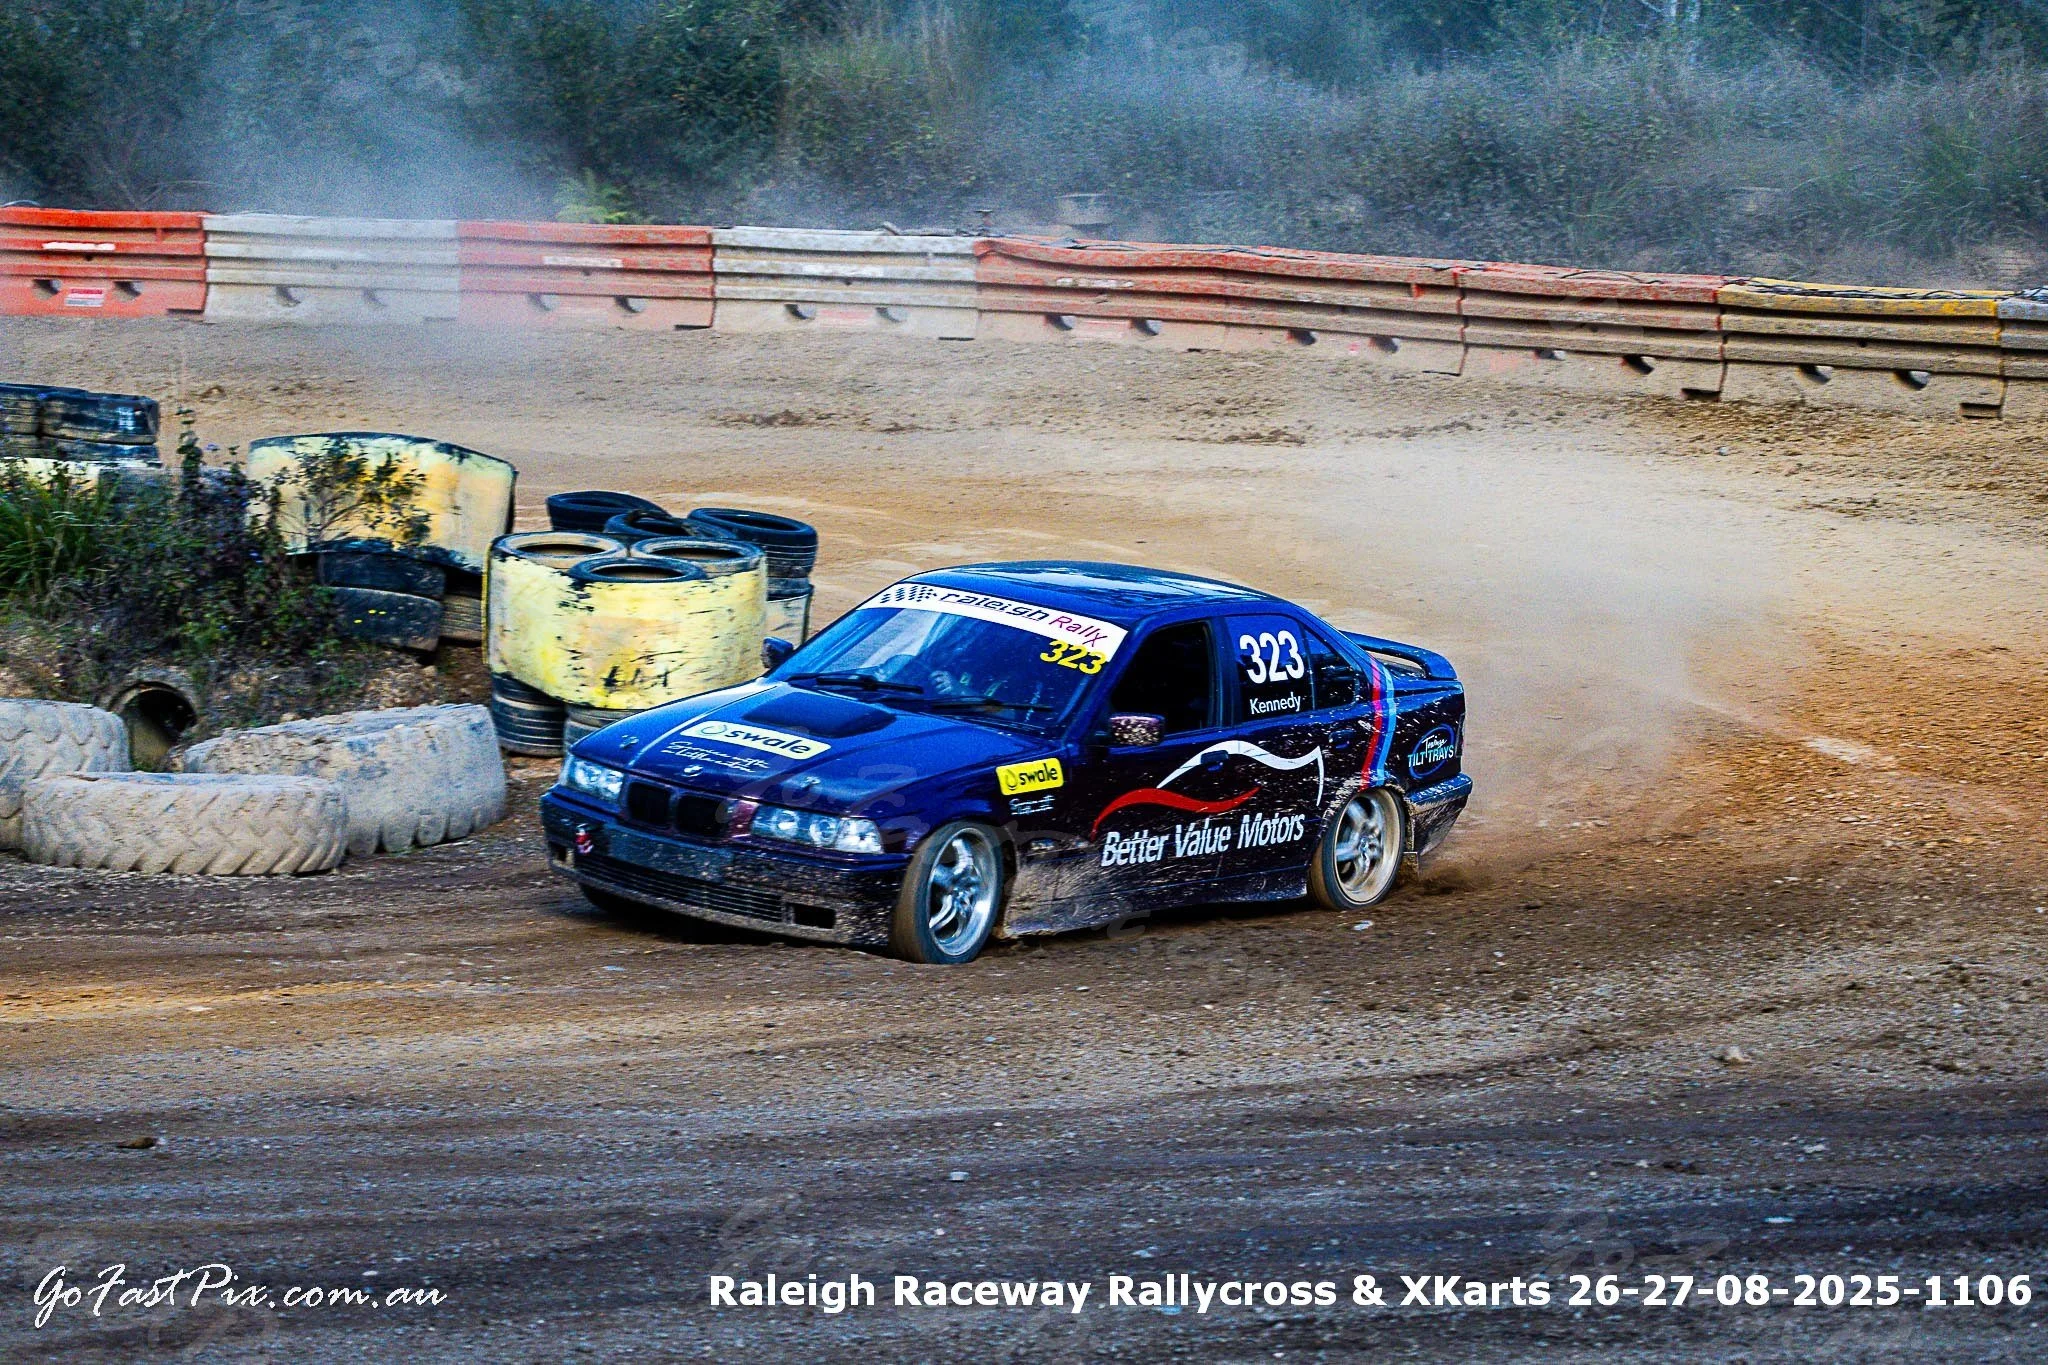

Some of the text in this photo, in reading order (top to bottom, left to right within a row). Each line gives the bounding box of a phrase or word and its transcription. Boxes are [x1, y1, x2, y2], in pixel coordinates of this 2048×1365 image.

[941, 594, 1050, 621] raleigh
[1040, 640, 1107, 675] 323
[1239, 630, 1305, 684] 323
[1249, 691, 1301, 715] Kennedy
[725, 728, 812, 754] swale
[1407, 744, 1455, 768] TILT TRAYS
[1018, 763, 1059, 786] swale
[1101, 812, 1306, 867] Better Value Motors
